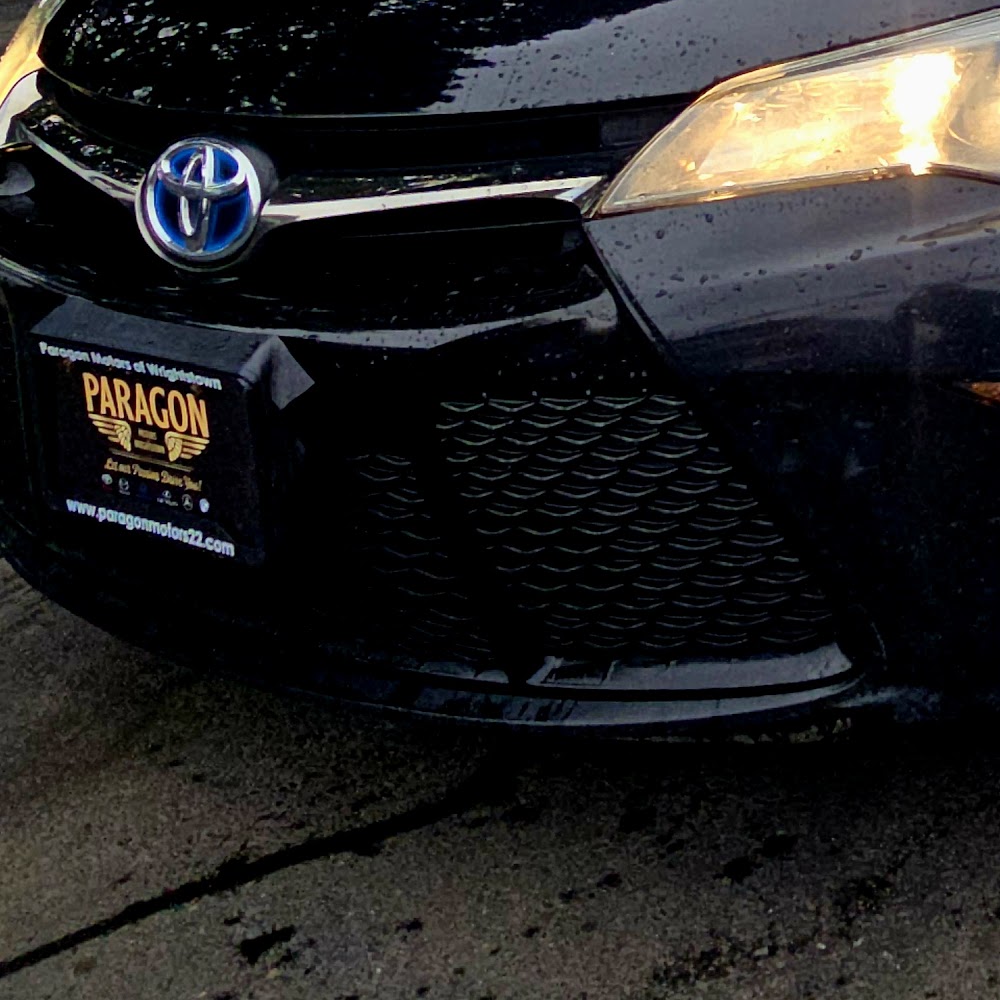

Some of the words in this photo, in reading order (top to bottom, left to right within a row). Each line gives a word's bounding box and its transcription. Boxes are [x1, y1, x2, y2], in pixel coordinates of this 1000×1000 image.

[38, 341, 90, 363] Paragon
[91, 351, 131, 371] Motors
[82, 371, 211, 438] PARAGON
[65, 498, 236, 557] www.paragonmotors22.com
